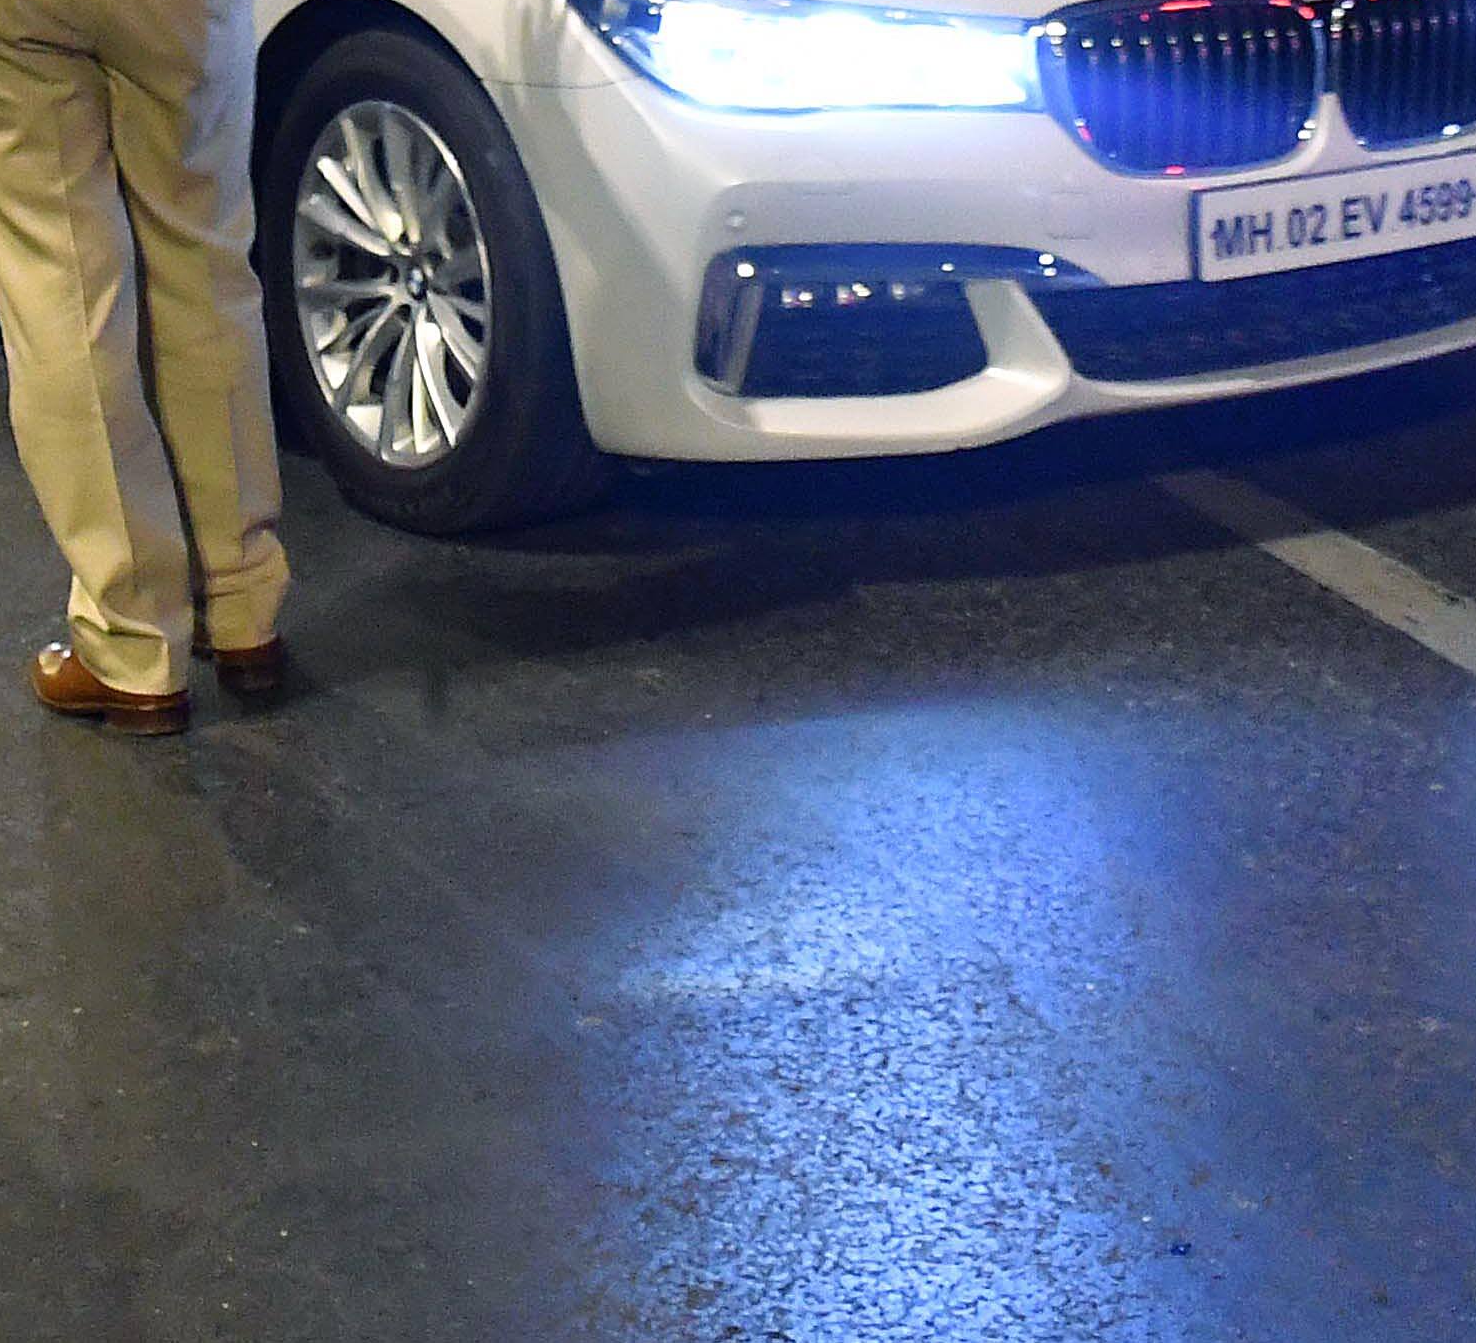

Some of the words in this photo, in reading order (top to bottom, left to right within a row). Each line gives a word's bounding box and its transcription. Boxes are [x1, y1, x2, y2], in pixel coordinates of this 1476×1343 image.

[1287, 204, 1327, 247] 02
[1341, 193, 1388, 237] EV
[1399, 178, 1472, 226] 4599
